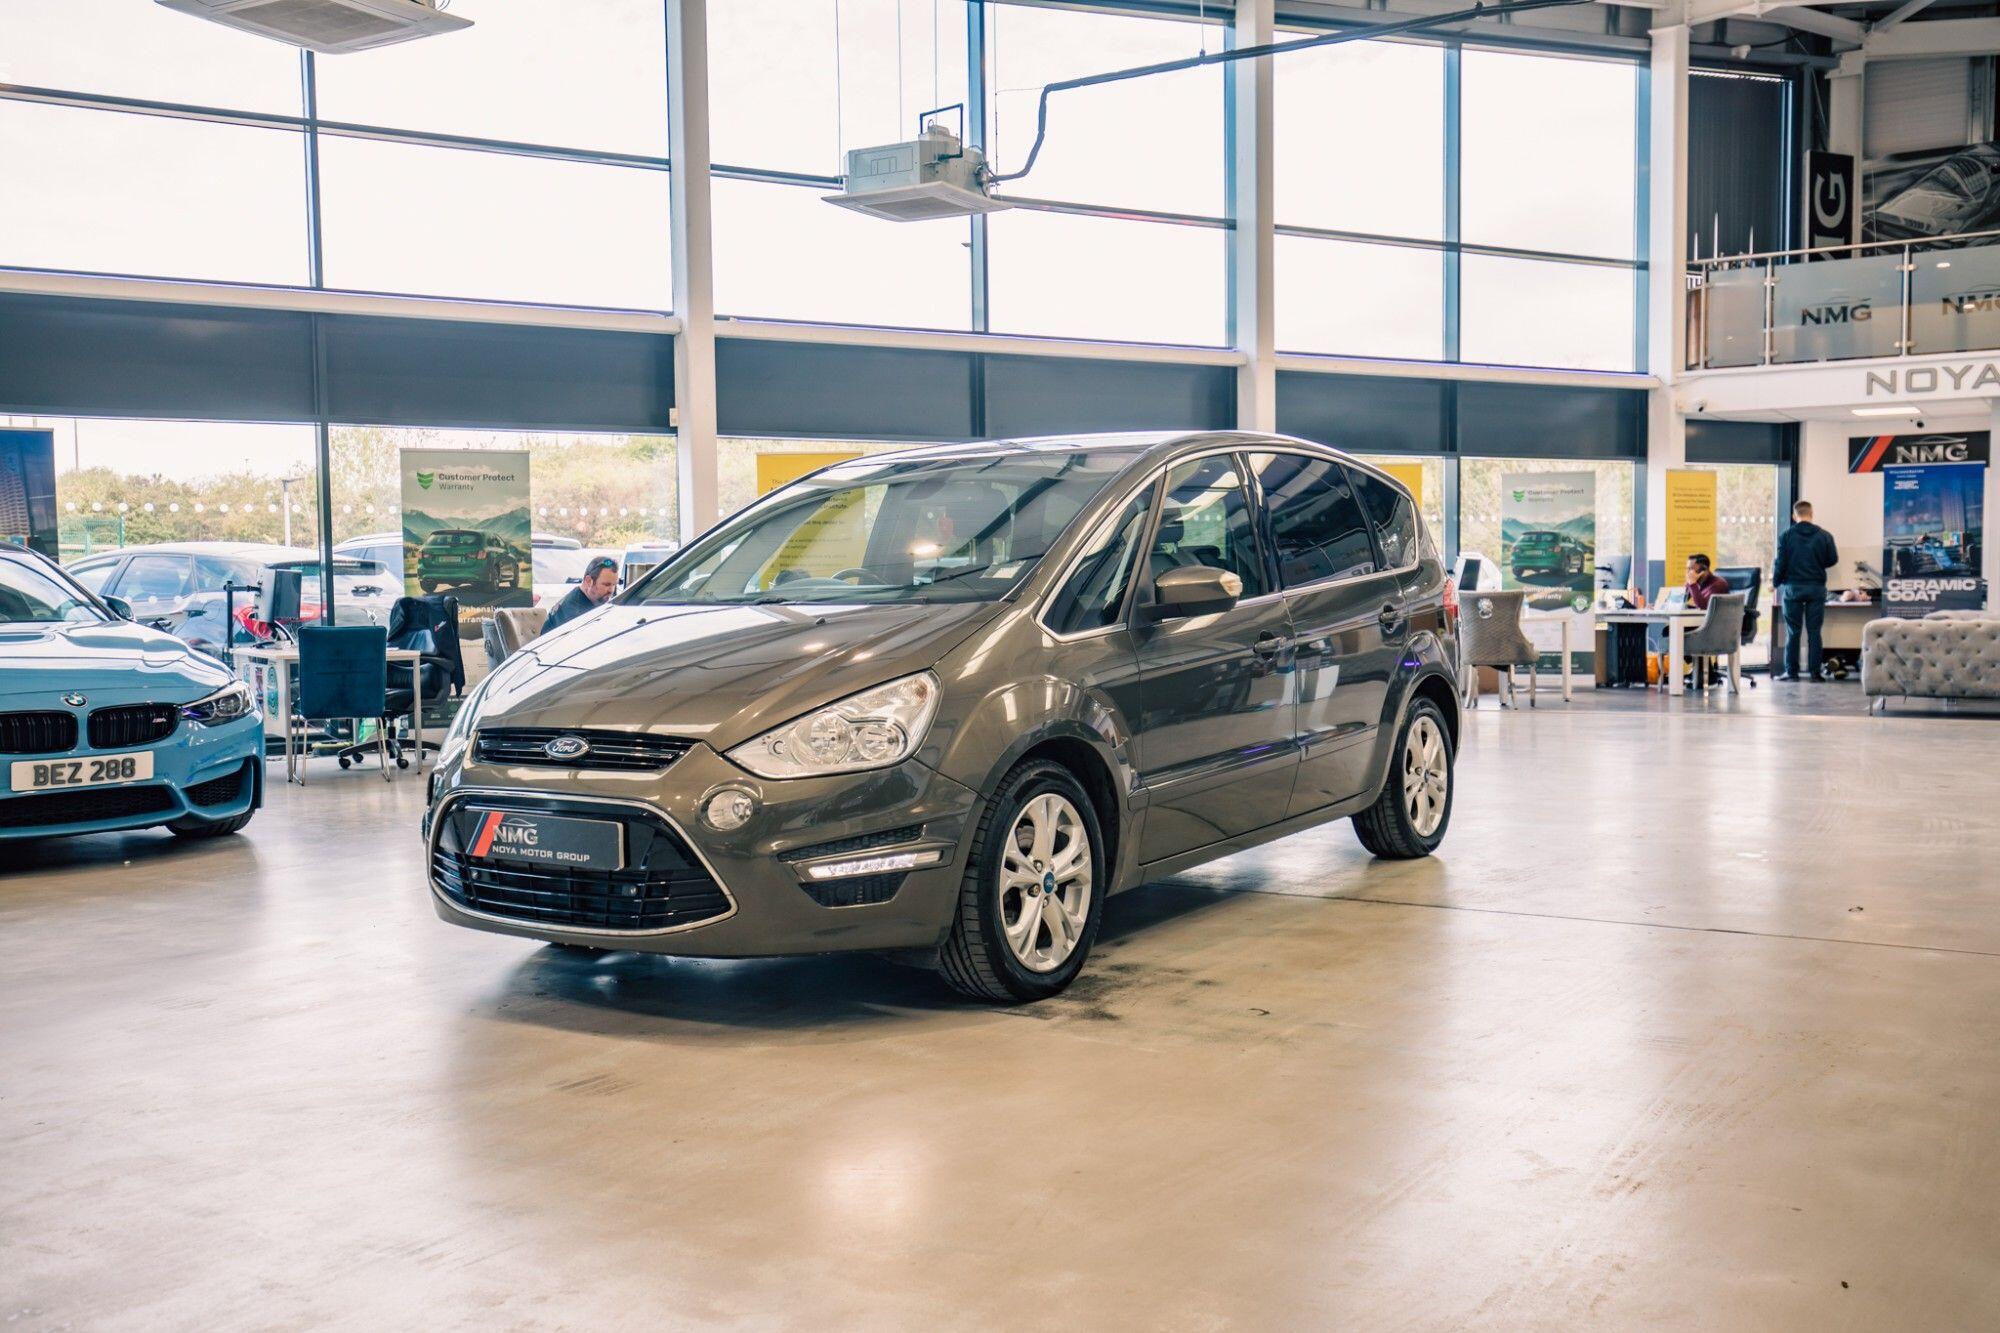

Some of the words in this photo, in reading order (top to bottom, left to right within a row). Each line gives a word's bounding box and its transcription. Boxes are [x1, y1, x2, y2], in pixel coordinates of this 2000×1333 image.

[1942, 293, 2000, 316] NM
[1801, 304, 1872, 326] NMG
[1866, 363, 2000, 396] NOYA
[1896, 443, 1968, 464] NMG
[438, 473, 481, 481] Customer
[482, 473, 515, 482] Protect
[439, 483, 474, 491] Warranty
[1887, 579, 1977, 591] CERAMIC
[1887, 590, 1941, 602] COAT
[552, 740, 579, 754] Ford
[33, 762, 83, 787] BEZ
[90, 757, 136, 782] 288
[492, 825, 539, 845] NMG
[492, 845, 517, 855] NOYA
[520, 847, 553, 859] MOTOR
[556, 850, 590, 862] GROUP
